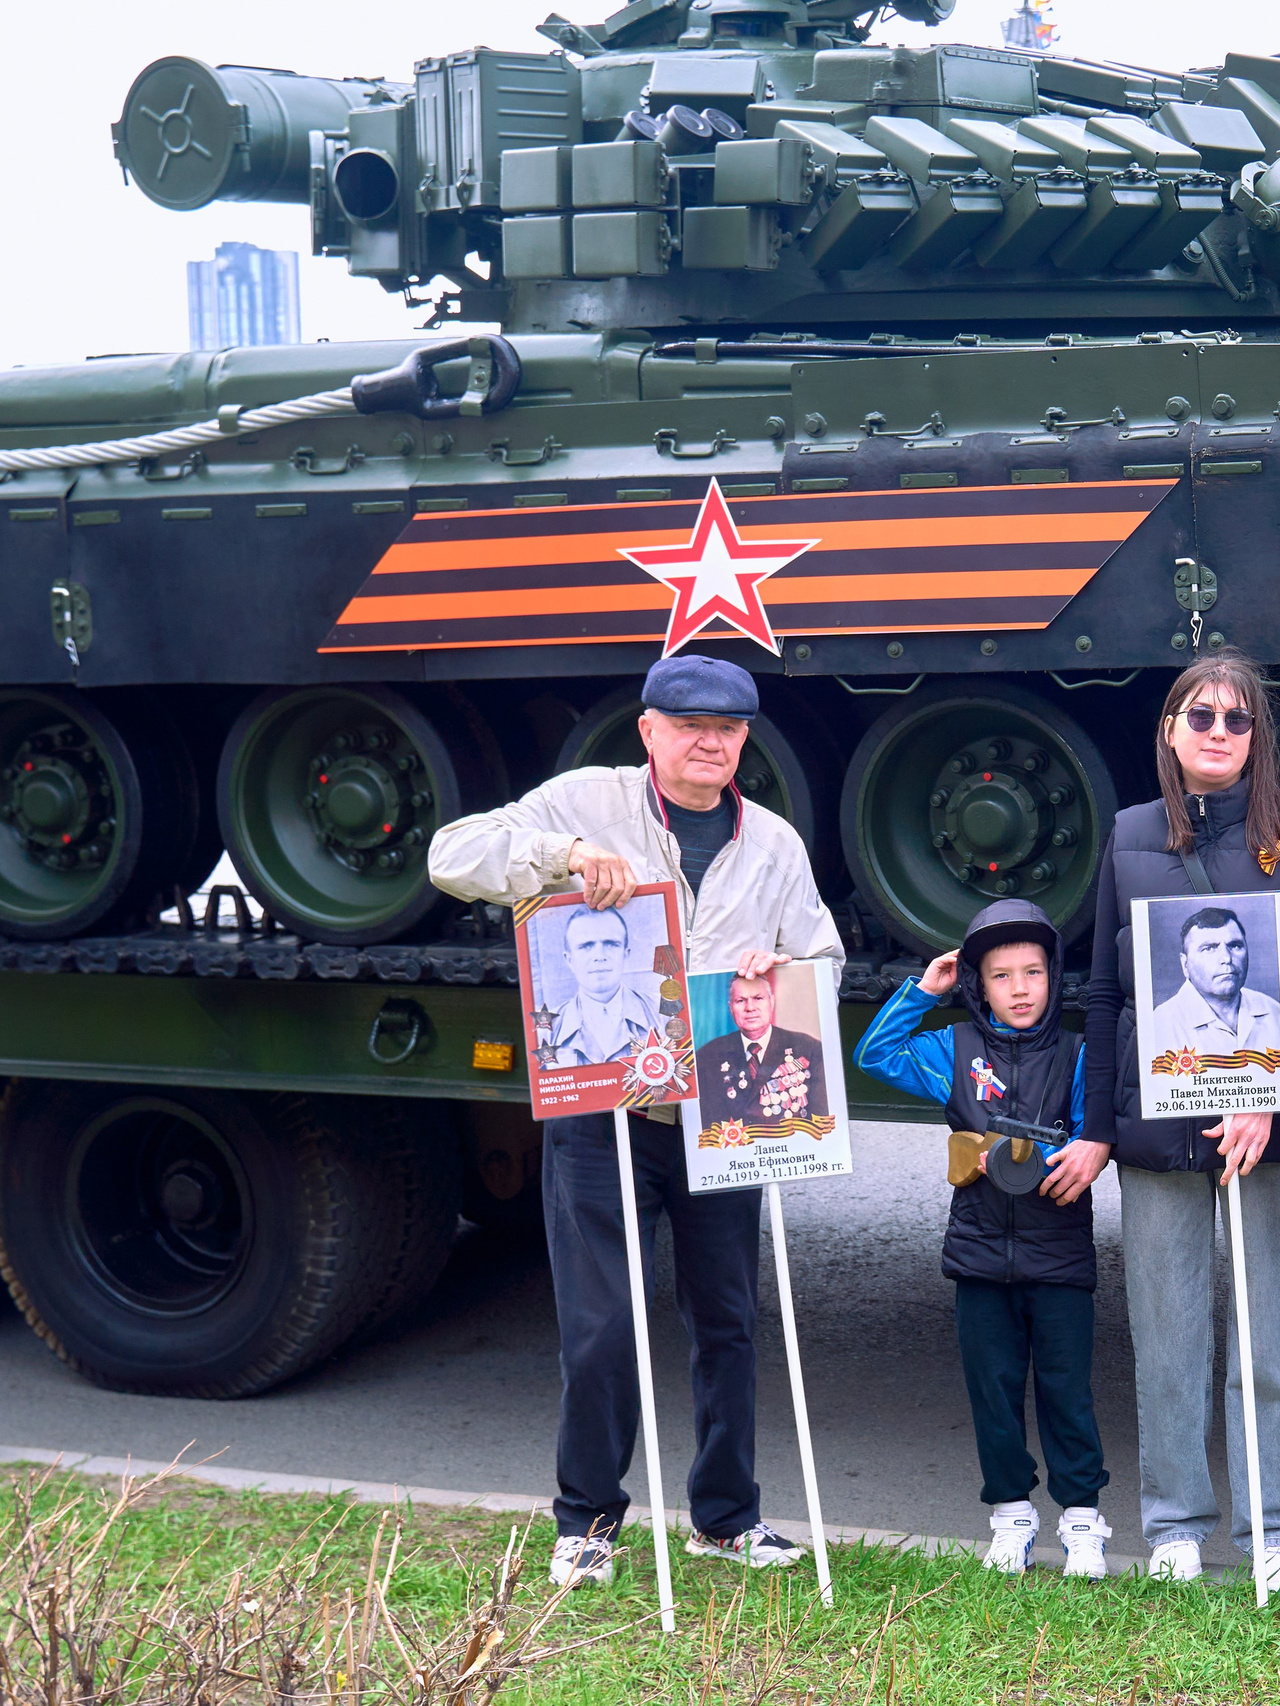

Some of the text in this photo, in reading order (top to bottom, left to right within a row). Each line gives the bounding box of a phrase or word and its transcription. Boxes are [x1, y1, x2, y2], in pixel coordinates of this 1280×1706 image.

[538, 1075, 574, 1086] ПАРАХИН
[539, 1078, 618, 1094] НИКОЛАЙ СЕРГЕЕВИЧ
[1193, 1074, 1253, 1086] Никитенко
[1170, 1085, 1277, 1099] Павел Михайлович
[540, 1096, 558, 1106] 1922
[562, 1094, 580, 1104] 1962
[1155, 1096, 1277, 1112] 29.06.1914-25.11.1990
[753, 1144, 789, 1156] Ланец
[728, 1153, 816, 1171] Яков Ефимович
[701, 1170, 760, 1187] 27.04.1919
[771, 1162, 828, 1178] 11.11.1998
[831, 1163, 845, 1172] гг.
